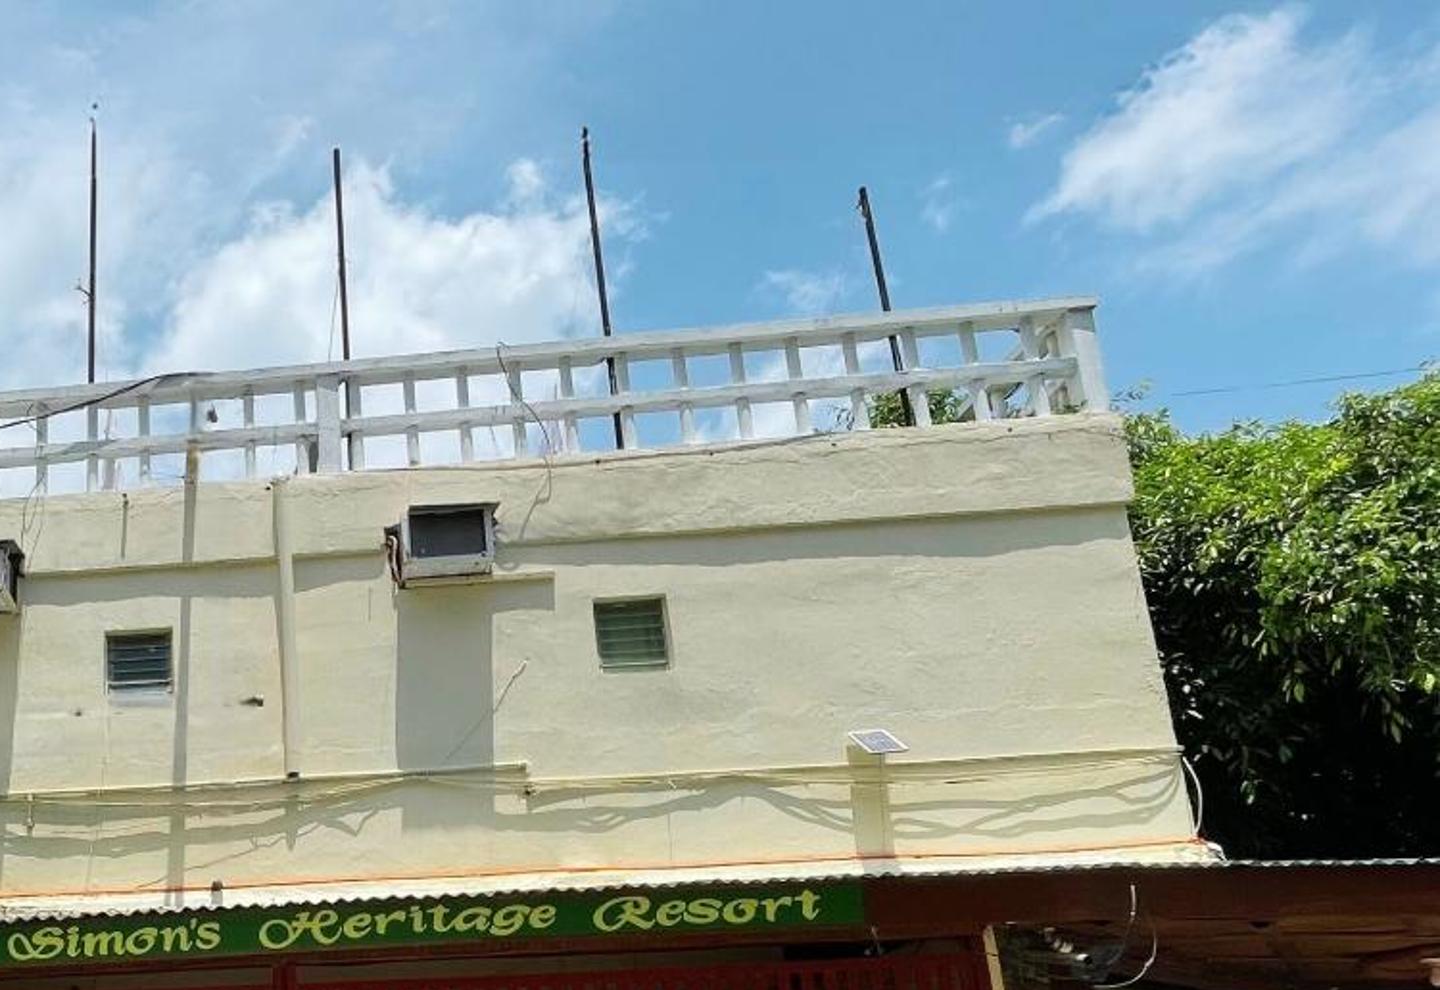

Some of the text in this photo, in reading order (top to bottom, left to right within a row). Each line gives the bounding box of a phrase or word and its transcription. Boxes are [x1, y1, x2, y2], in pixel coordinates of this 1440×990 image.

[8, 888, 820, 960] Simon's Heritage Resort
